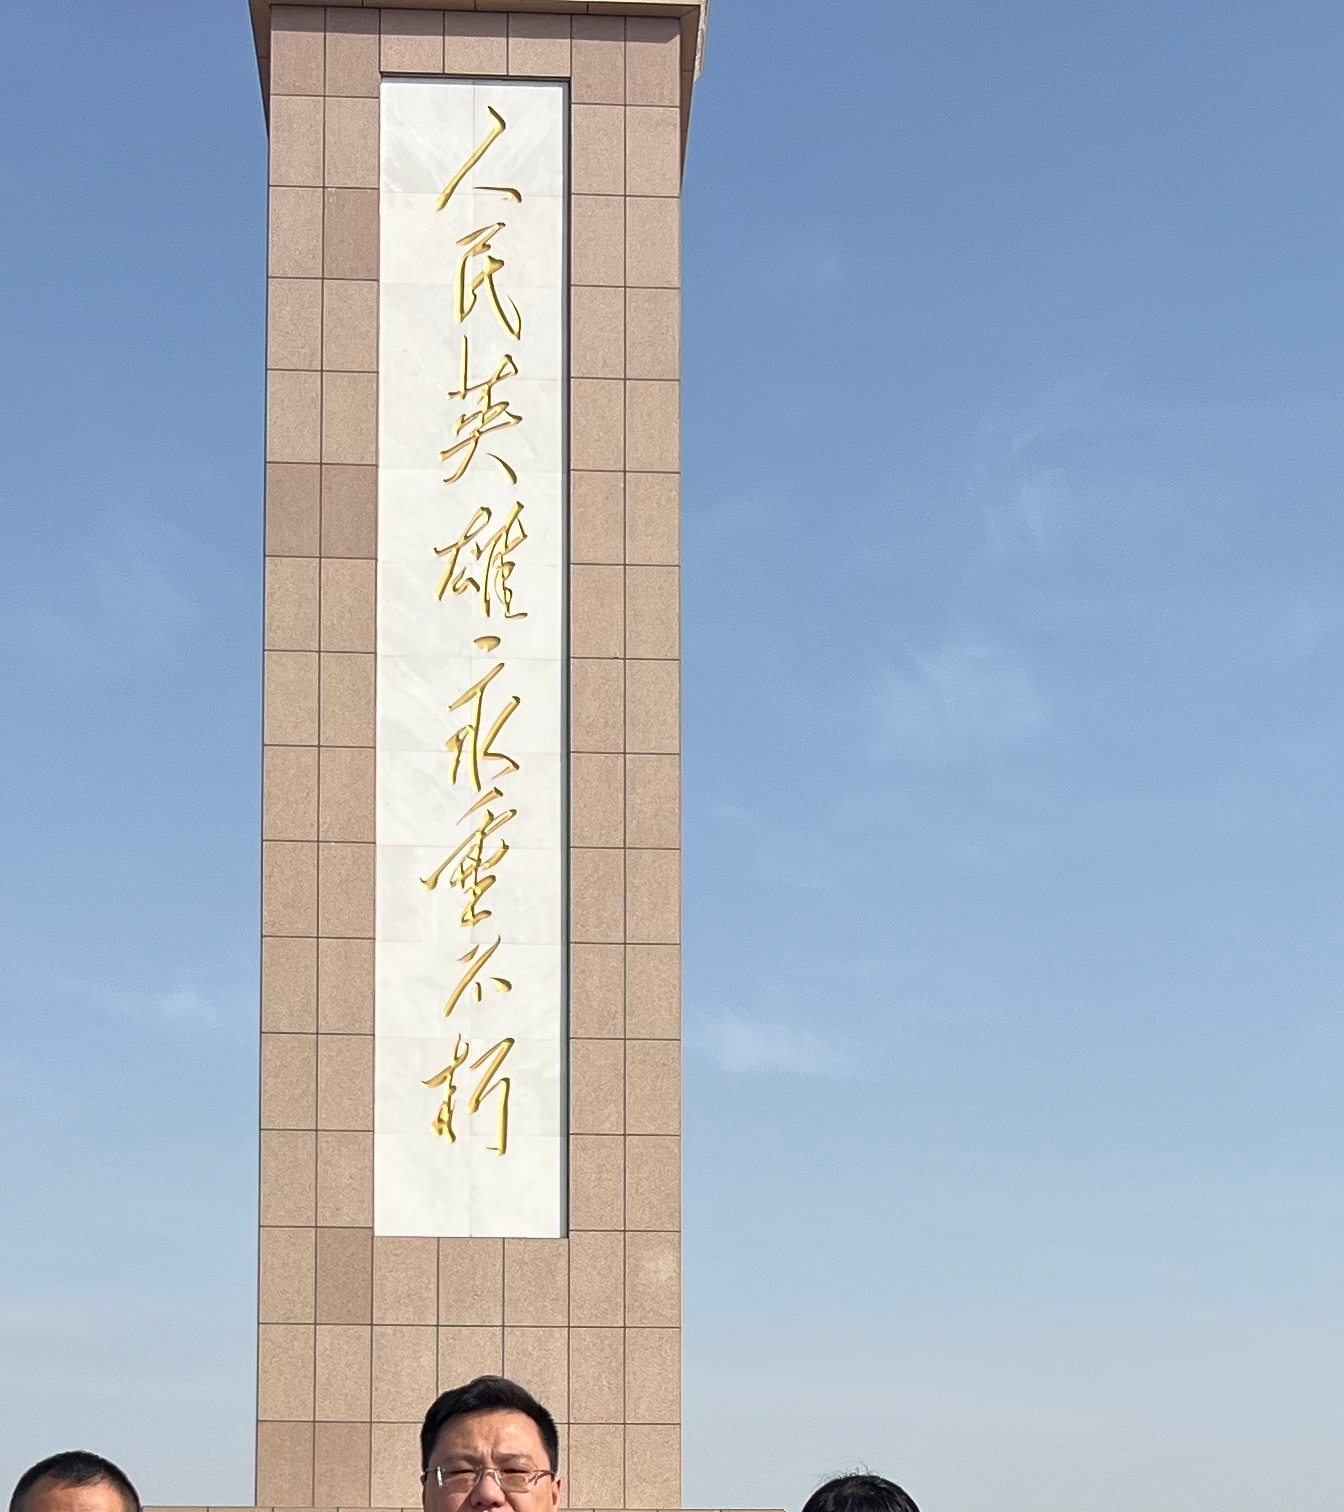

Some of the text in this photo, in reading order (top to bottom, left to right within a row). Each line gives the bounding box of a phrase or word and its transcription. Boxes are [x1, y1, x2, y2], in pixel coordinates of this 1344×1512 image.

[421, 105, 528, 1156] 人民英雄永垂不朽
